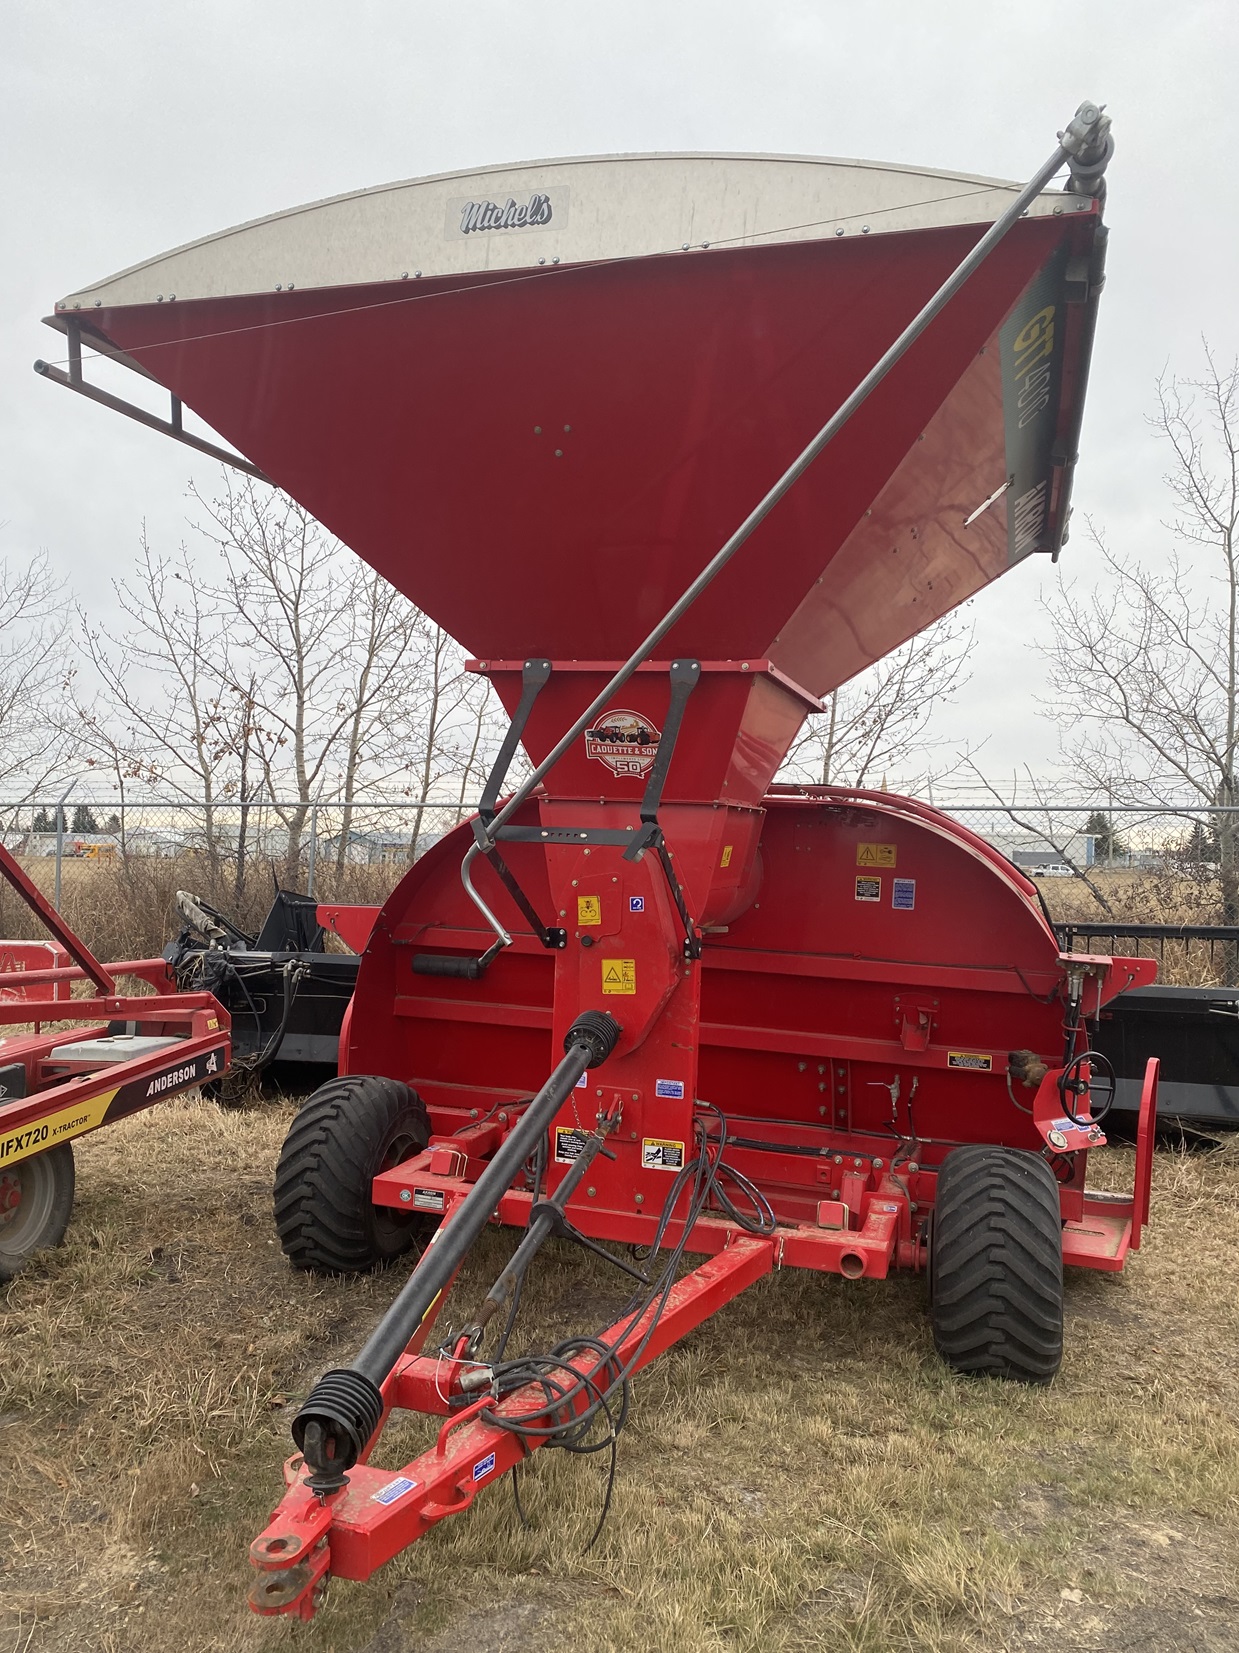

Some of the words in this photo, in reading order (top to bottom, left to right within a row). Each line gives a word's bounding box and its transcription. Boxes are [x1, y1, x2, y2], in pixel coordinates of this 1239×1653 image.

[460, 193, 552, 234] Michel's
[616, 760, 641, 773] 50
[641, 747, 658, 755] SON
[146, 1063, 196, 1097] ANDERSON
[0, 1124, 49, 1159] IFX720
